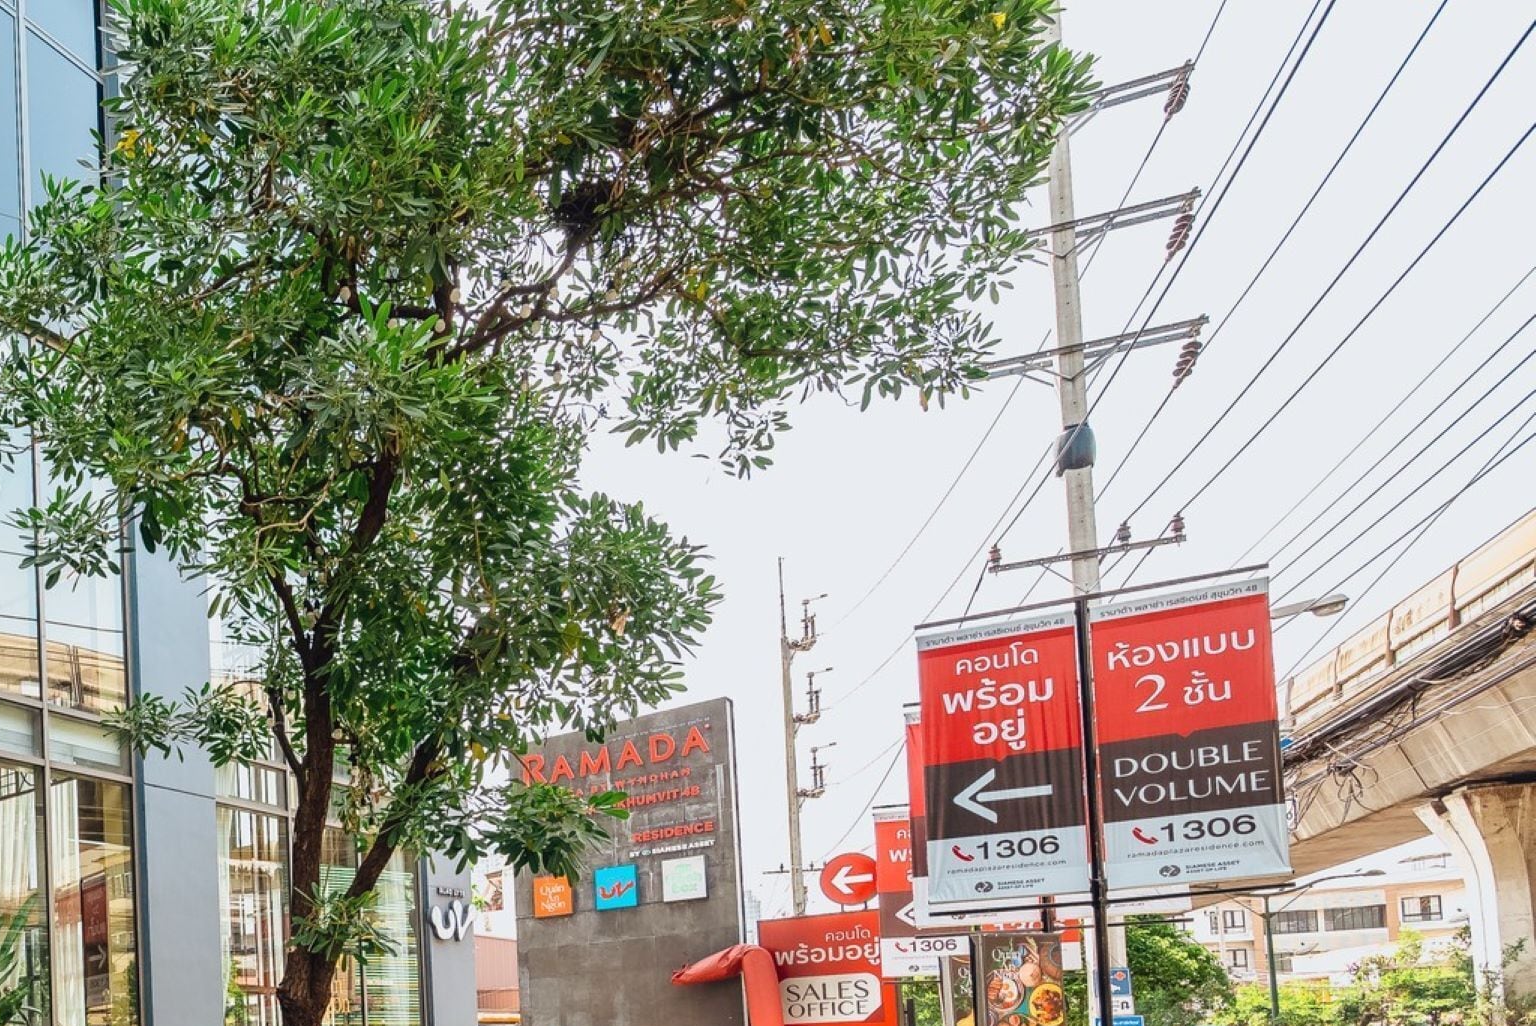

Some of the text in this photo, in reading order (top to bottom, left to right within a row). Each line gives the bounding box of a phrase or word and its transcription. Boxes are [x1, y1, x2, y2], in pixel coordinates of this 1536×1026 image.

[955, 641, 1039, 676] คอนโด
[1107, 628, 1255, 671] ห้องแบบ
[942, 677, 1054, 715] พร้อม
[1134, 669, 1232, 713] 2 ชั้น
[972, 708, 1026, 751] อยู่
[521, 725, 710, 787] RAMADA
[1114, 739, 1263, 778] DOUBLE
[1114, 770, 1271, 807] VOLUME
[632, 821, 714, 843] RESIDENCE
[1160, 814, 1256, 842] 1306
[976, 835, 1060, 860] 1306
[1127, 839, 1265, 859] ramadaplazaresidence.com
[825, 924, 871, 942] คอนโด
[909, 938, 958, 952] 1306
[775, 936, 881, 966] พร้อมอยู่
[786, 979, 869, 1003] SALES
[788, 999, 869, 1019] OFFICE
